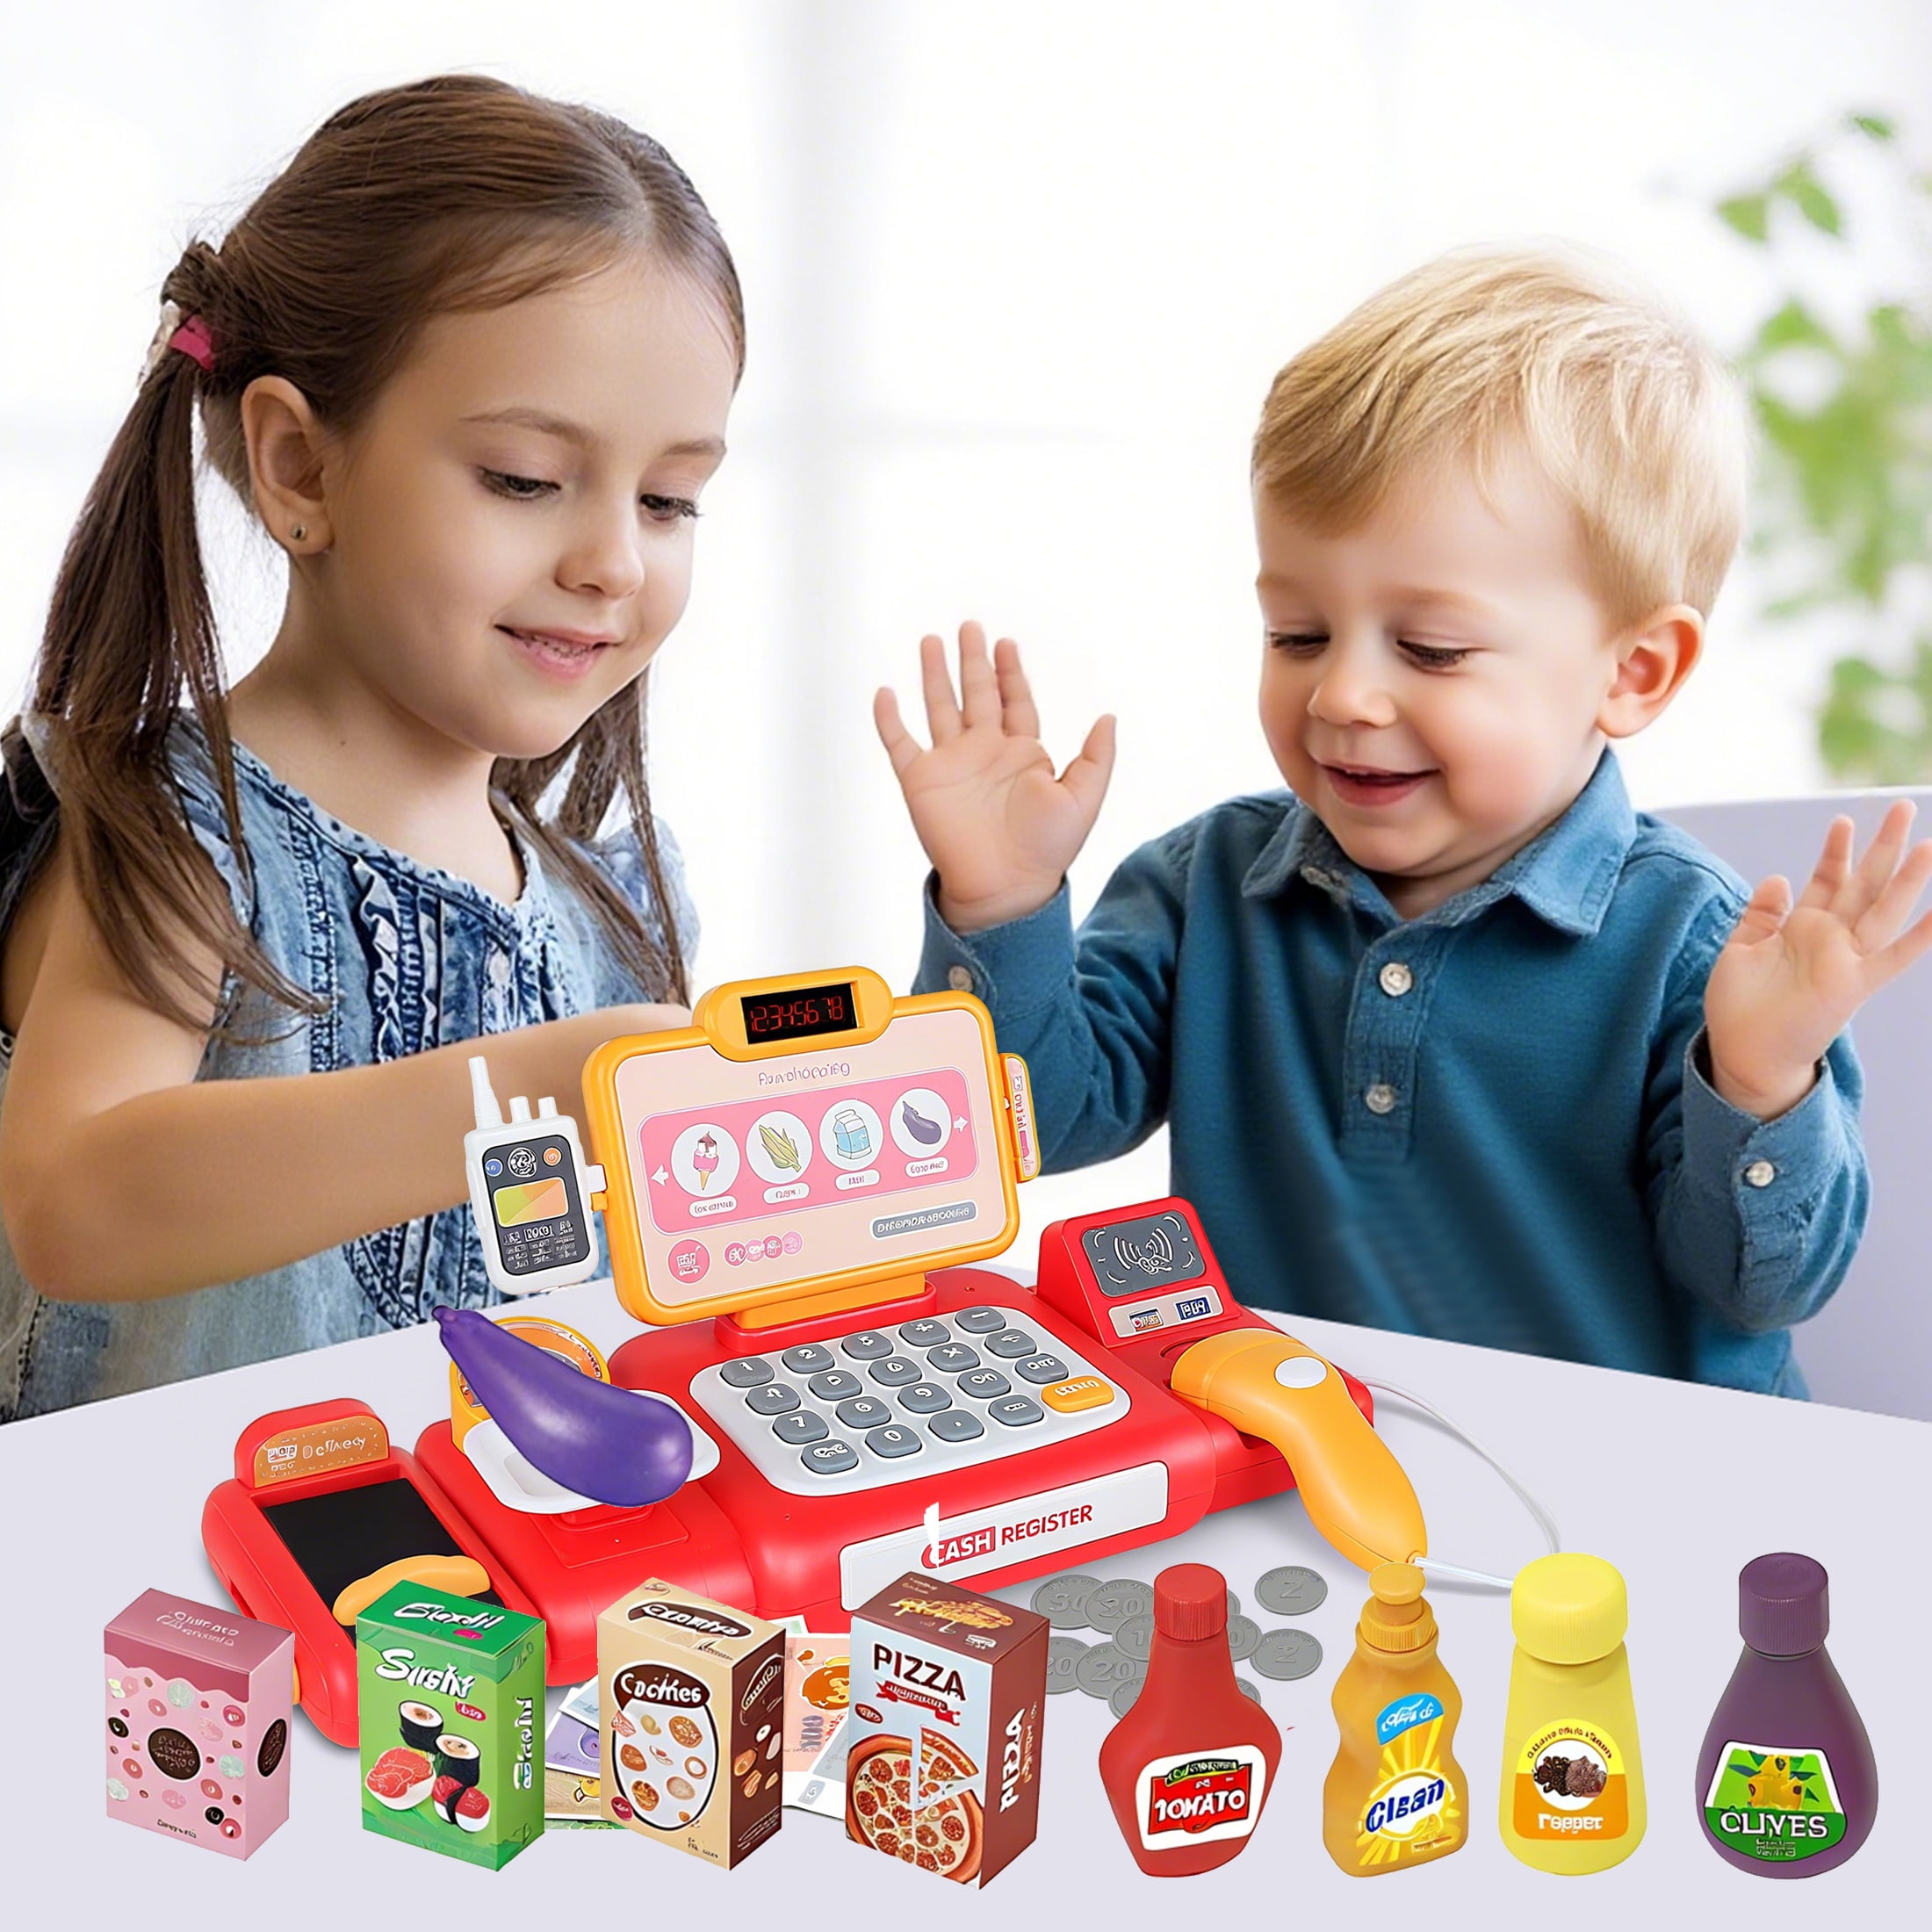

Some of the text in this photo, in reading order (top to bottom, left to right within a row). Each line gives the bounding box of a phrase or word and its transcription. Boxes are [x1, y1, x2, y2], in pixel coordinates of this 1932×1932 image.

[929, 1504, 1093, 1565] CASH REGISTER
[873, 1643, 966, 1701] PIZZA
[1366, 1778, 1445, 1833] Clean
